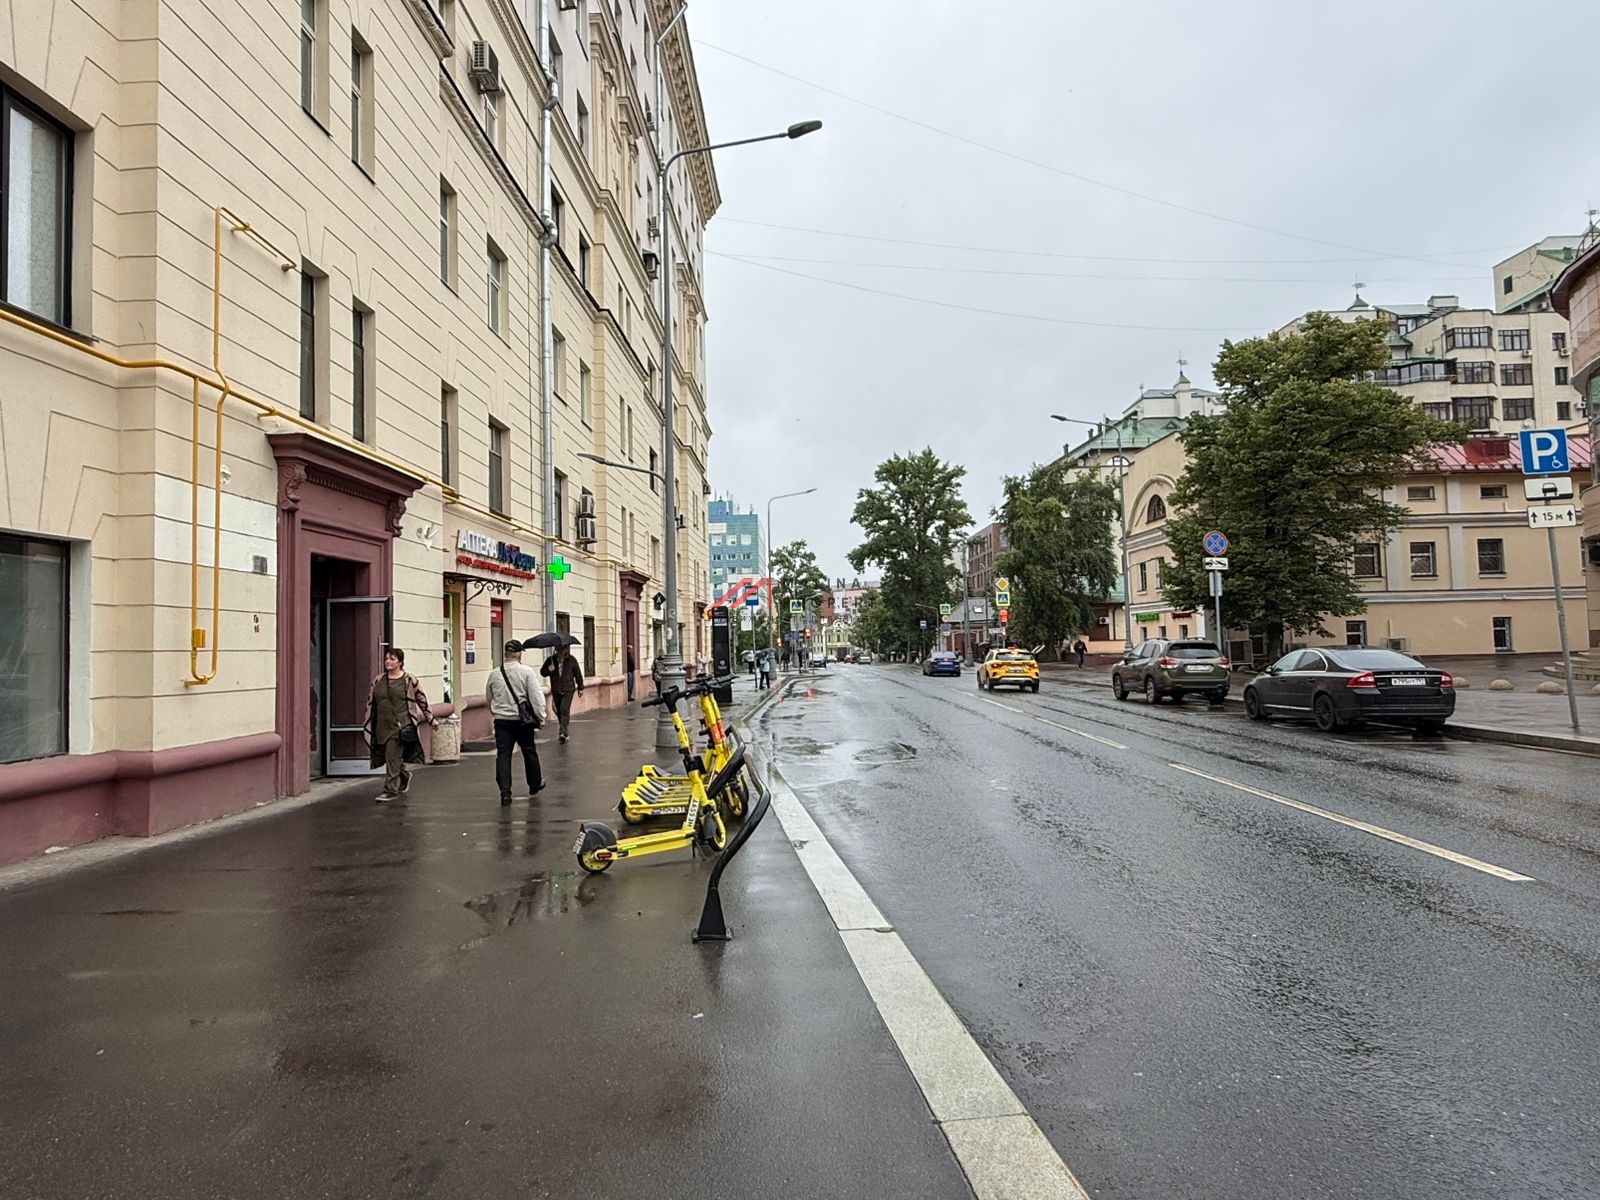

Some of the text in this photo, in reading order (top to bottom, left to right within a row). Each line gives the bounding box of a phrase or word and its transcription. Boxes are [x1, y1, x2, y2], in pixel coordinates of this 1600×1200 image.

[1529, 432, 1559, 470] P
[1542, 511, 1553, 521] 15
[458, 529, 498, 558] АПТЕКА
